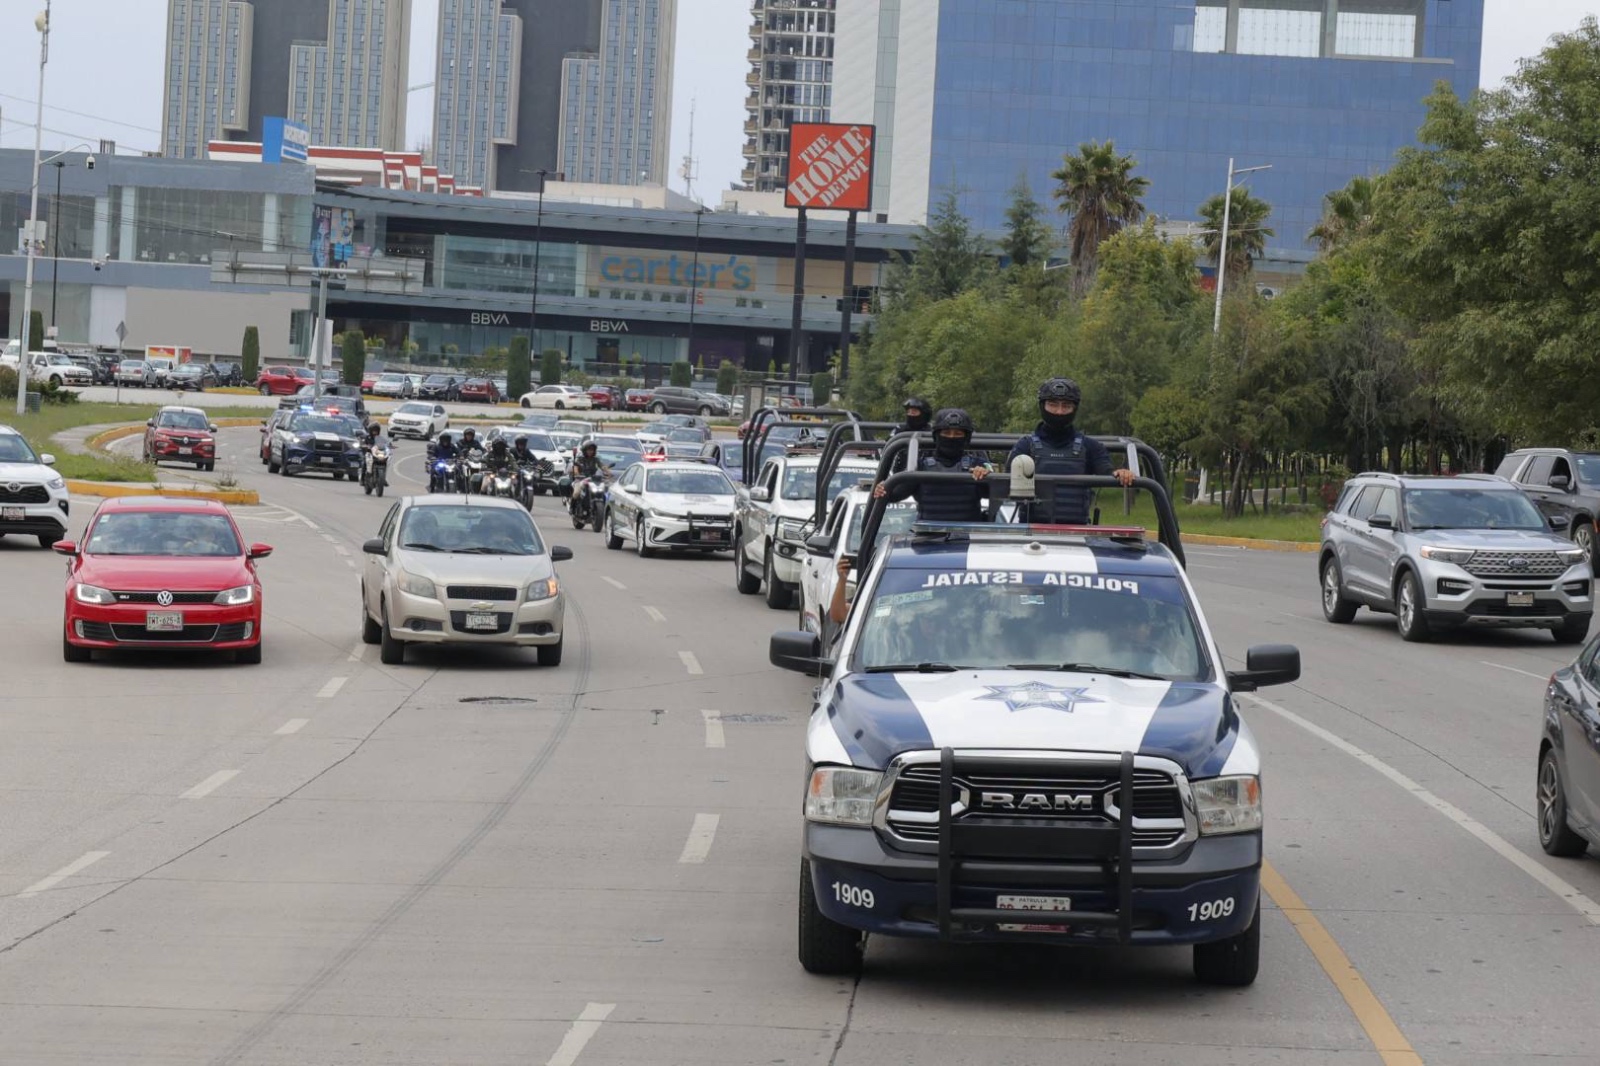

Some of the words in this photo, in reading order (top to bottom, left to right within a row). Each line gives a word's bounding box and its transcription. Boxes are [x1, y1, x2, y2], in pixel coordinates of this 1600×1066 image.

[798, 133, 832, 166] THE
[788, 125, 871, 206] HOME
[819, 156, 869, 207] DEPOT
[601, 254, 752, 291] carter's
[471, 312, 510, 325] BBVA
[590, 319, 629, 333] BBVA
[981, 791, 1093, 810] RAM
[832, 881, 875, 909] 1909
[1187, 896, 1235, 922] 1909
